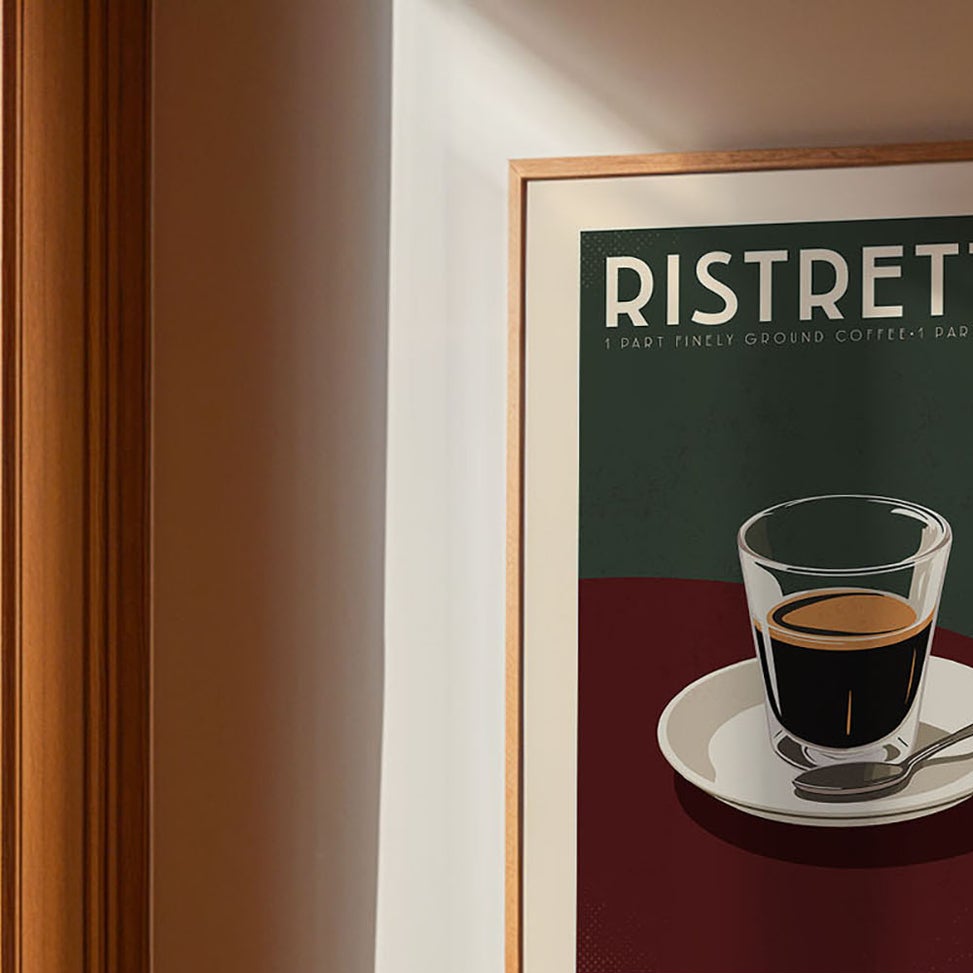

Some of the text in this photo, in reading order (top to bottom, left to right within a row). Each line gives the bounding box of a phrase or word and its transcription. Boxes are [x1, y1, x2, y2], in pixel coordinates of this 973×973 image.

[605, 338, 611, 349] 1
[620, 336, 663, 349] PART
[675, 334, 734, 348] FINELY
[744, 330, 825, 345] GROUND
